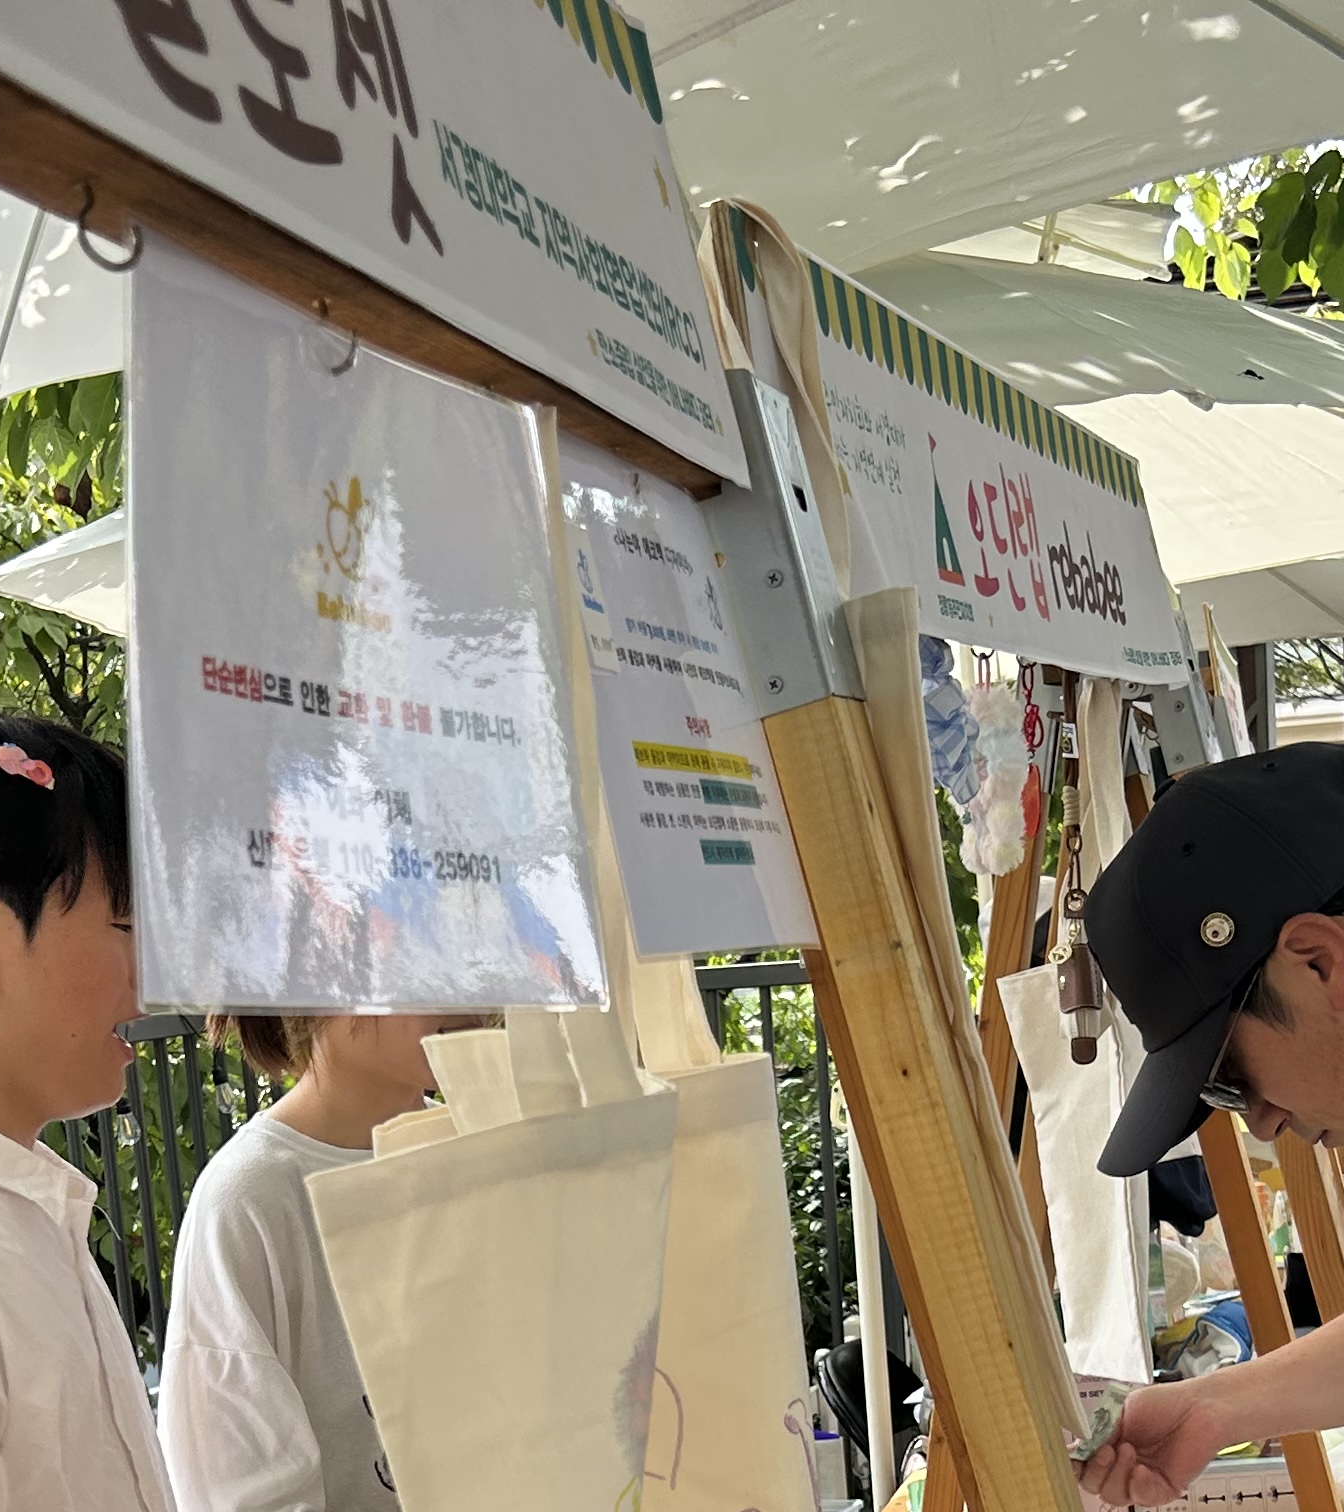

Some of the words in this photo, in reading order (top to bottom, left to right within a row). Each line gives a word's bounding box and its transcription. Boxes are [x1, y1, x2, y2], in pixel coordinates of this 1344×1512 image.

[433, 119, 540, 248] 서경대학교
[1047, 520, 1127, 626] rebabee
[202, 656, 293, 707] 단순변심으로
[301, 677, 331, 717] 인한
[338, 690, 369, 725] 교환
[375, 695, 394, 728] 및
[439, 706, 521, 747] 불가합니다.
